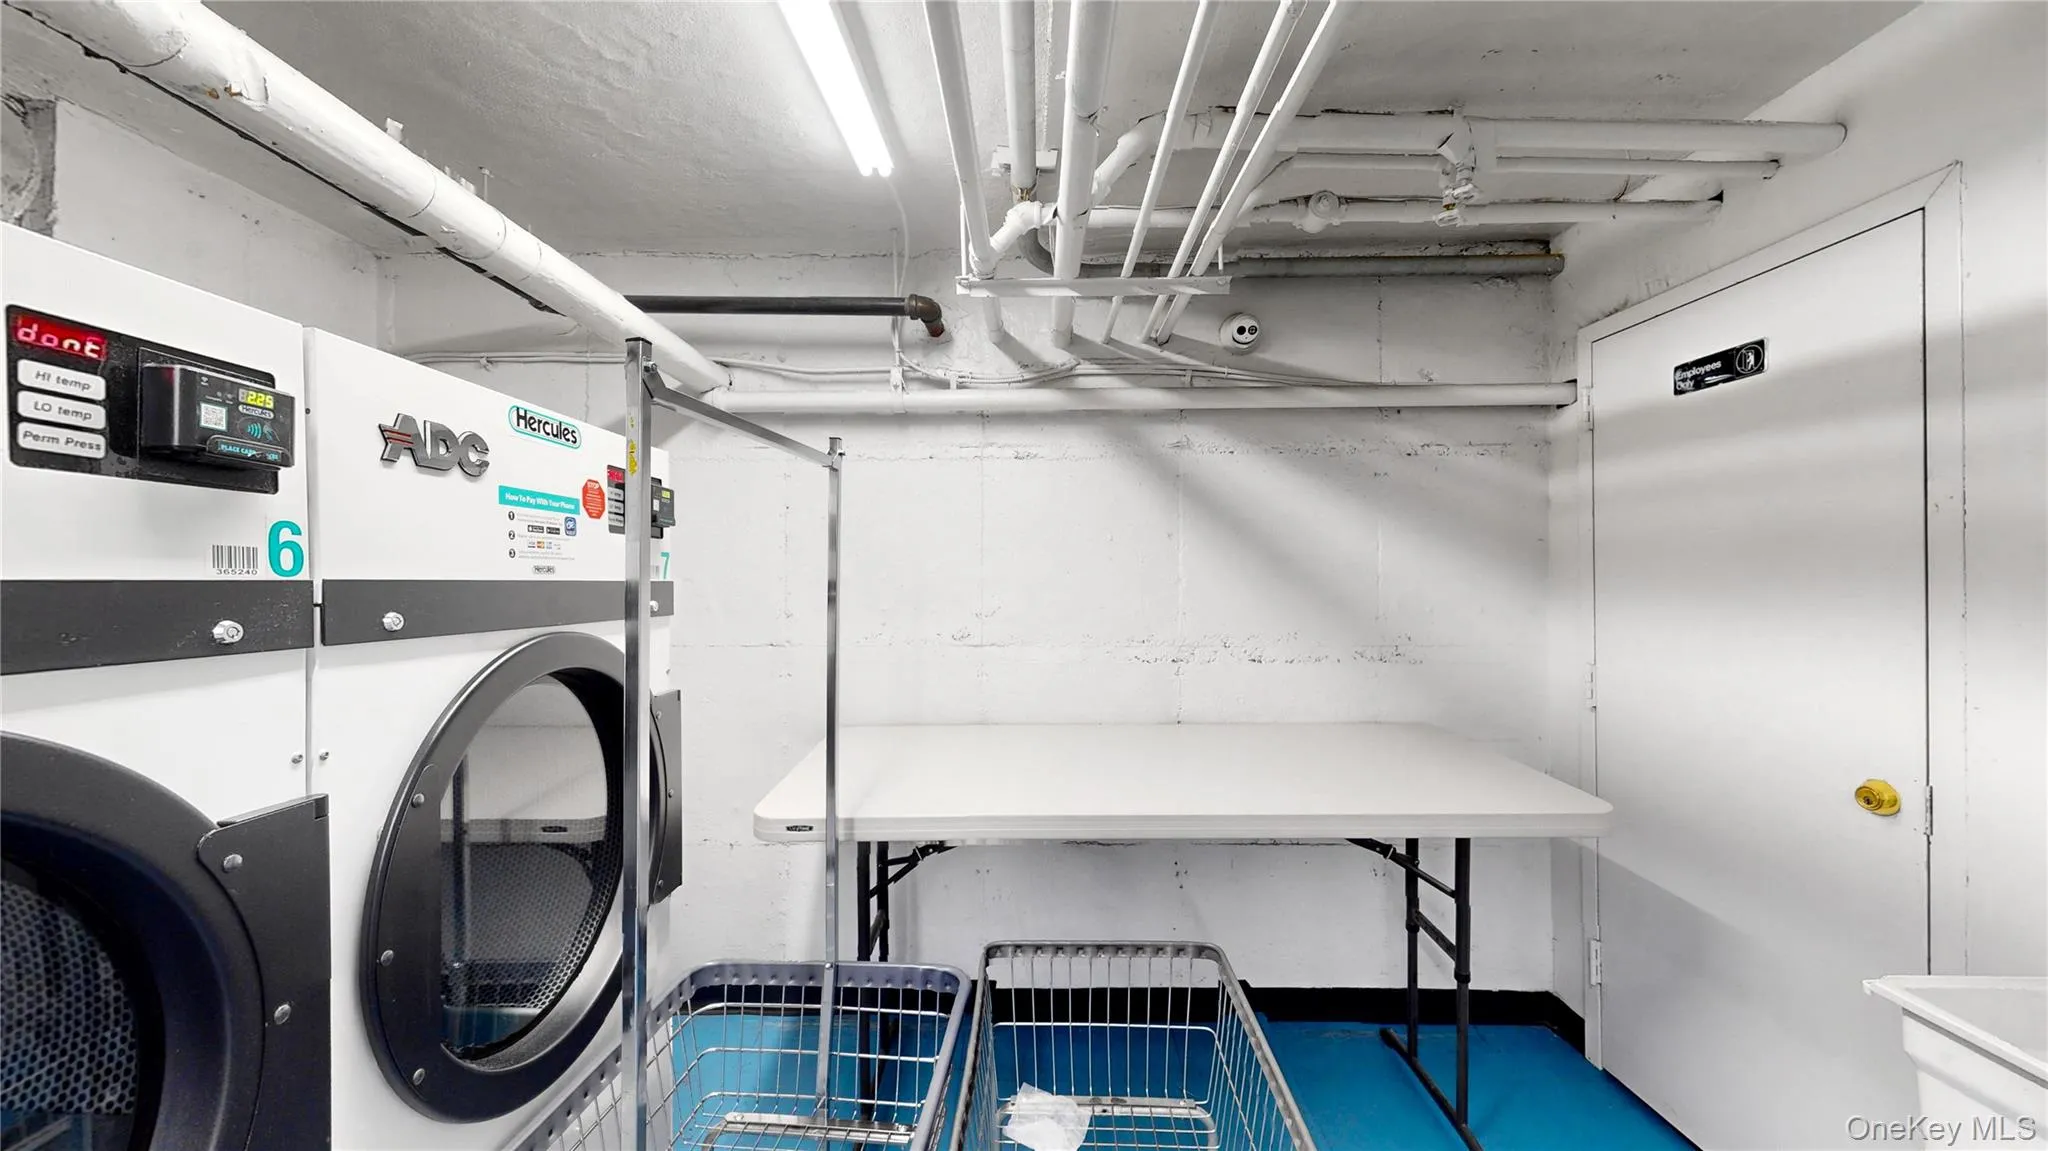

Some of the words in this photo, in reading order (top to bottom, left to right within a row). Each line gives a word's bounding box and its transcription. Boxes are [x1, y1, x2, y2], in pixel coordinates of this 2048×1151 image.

[1675, 361, 1722, 380] Employees
[56, 375, 92, 391] temp
[33, 401, 52, 412] LO
[58, 406, 92, 421] temp
[242, 404, 272, 418] Hercules
[515, 407, 578, 445] Hercules
[23, 430, 60, 444] Perm
[64, 437, 102, 450] Press
[378, 413, 490, 477] ADC
[505, 492, 519, 501] How
[526, 496, 536, 505] Pay
[536, 497, 549, 505] With
[268, 520, 305, 578] 6
[216, 568, 258, 576] 365240
[661, 551, 670, 580] 7
